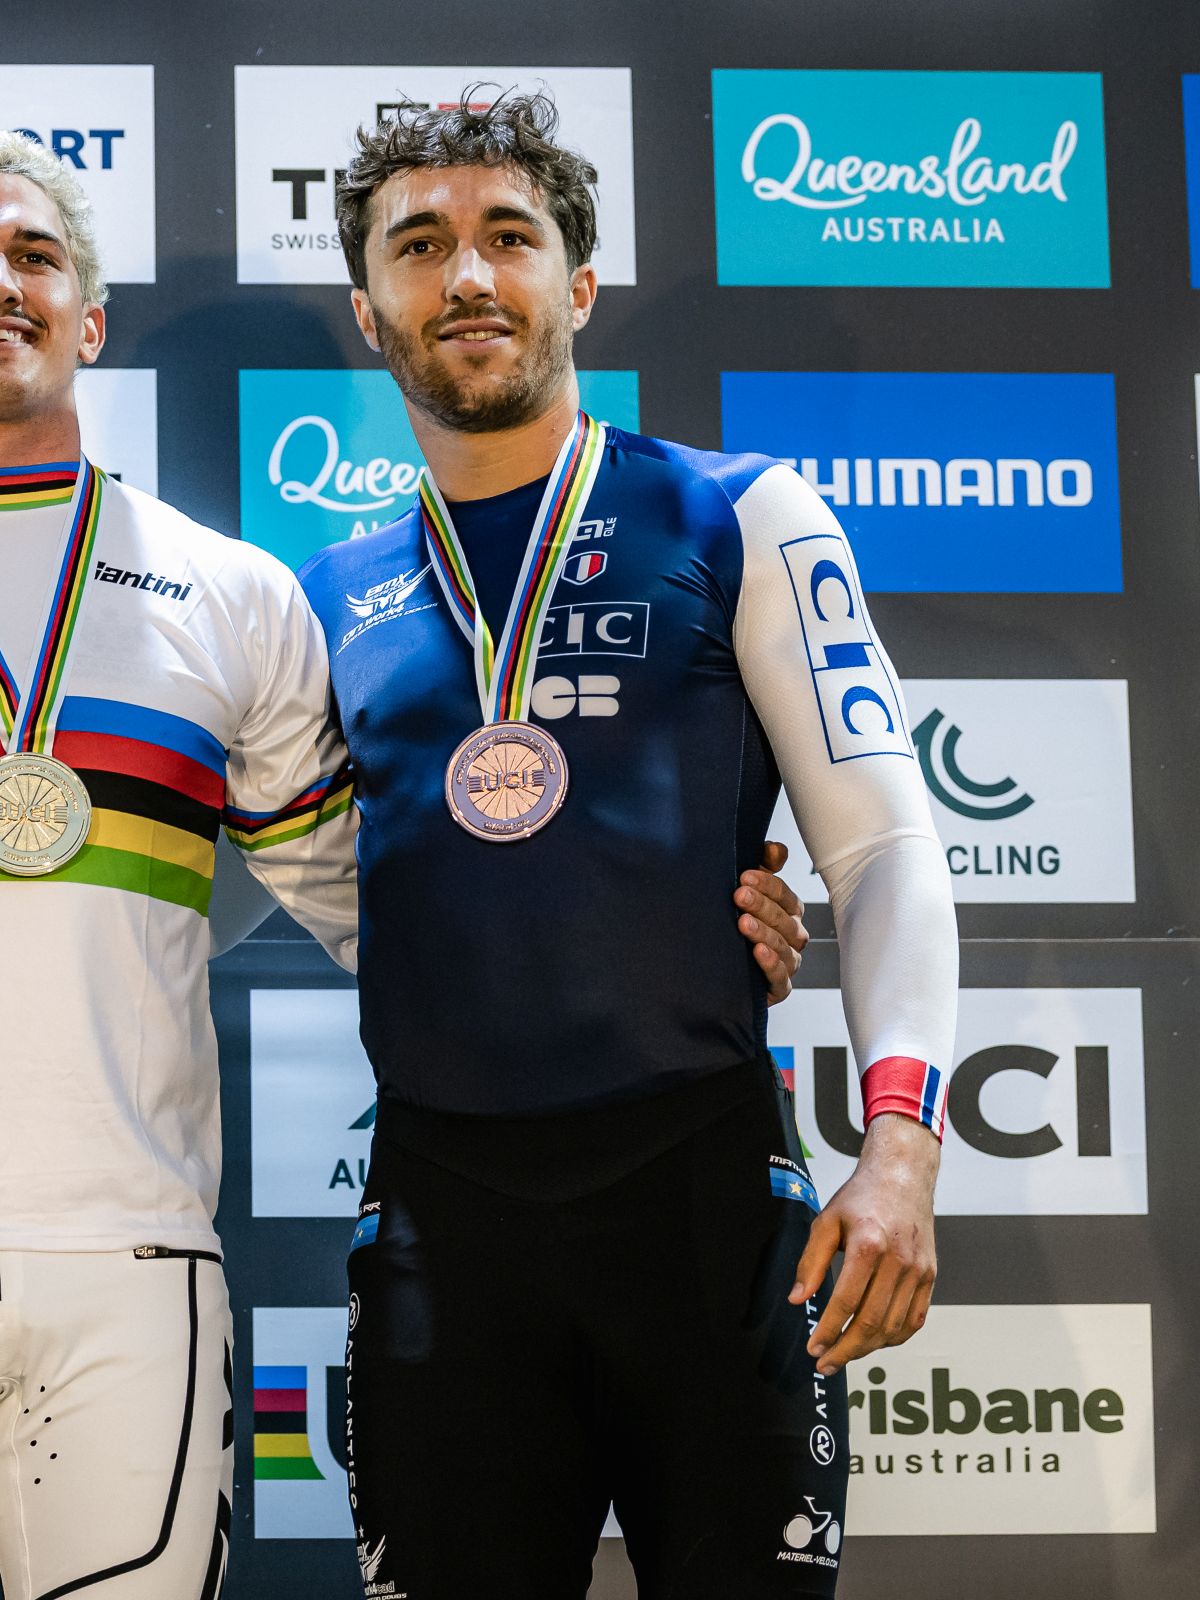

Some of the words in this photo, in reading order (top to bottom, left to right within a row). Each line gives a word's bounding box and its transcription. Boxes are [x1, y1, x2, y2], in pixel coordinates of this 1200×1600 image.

[741, 113, 1078, 210] Queensland
[822, 217, 1006, 243] AUSTRALIA
[783, 457, 1093, 508] HIMANO
[810, 559, 896, 736] CIC
[949, 845, 1061, 876] CLING
[848, 1366, 1124, 1435] isbane
[849, 1446, 1061, 1475] australia
